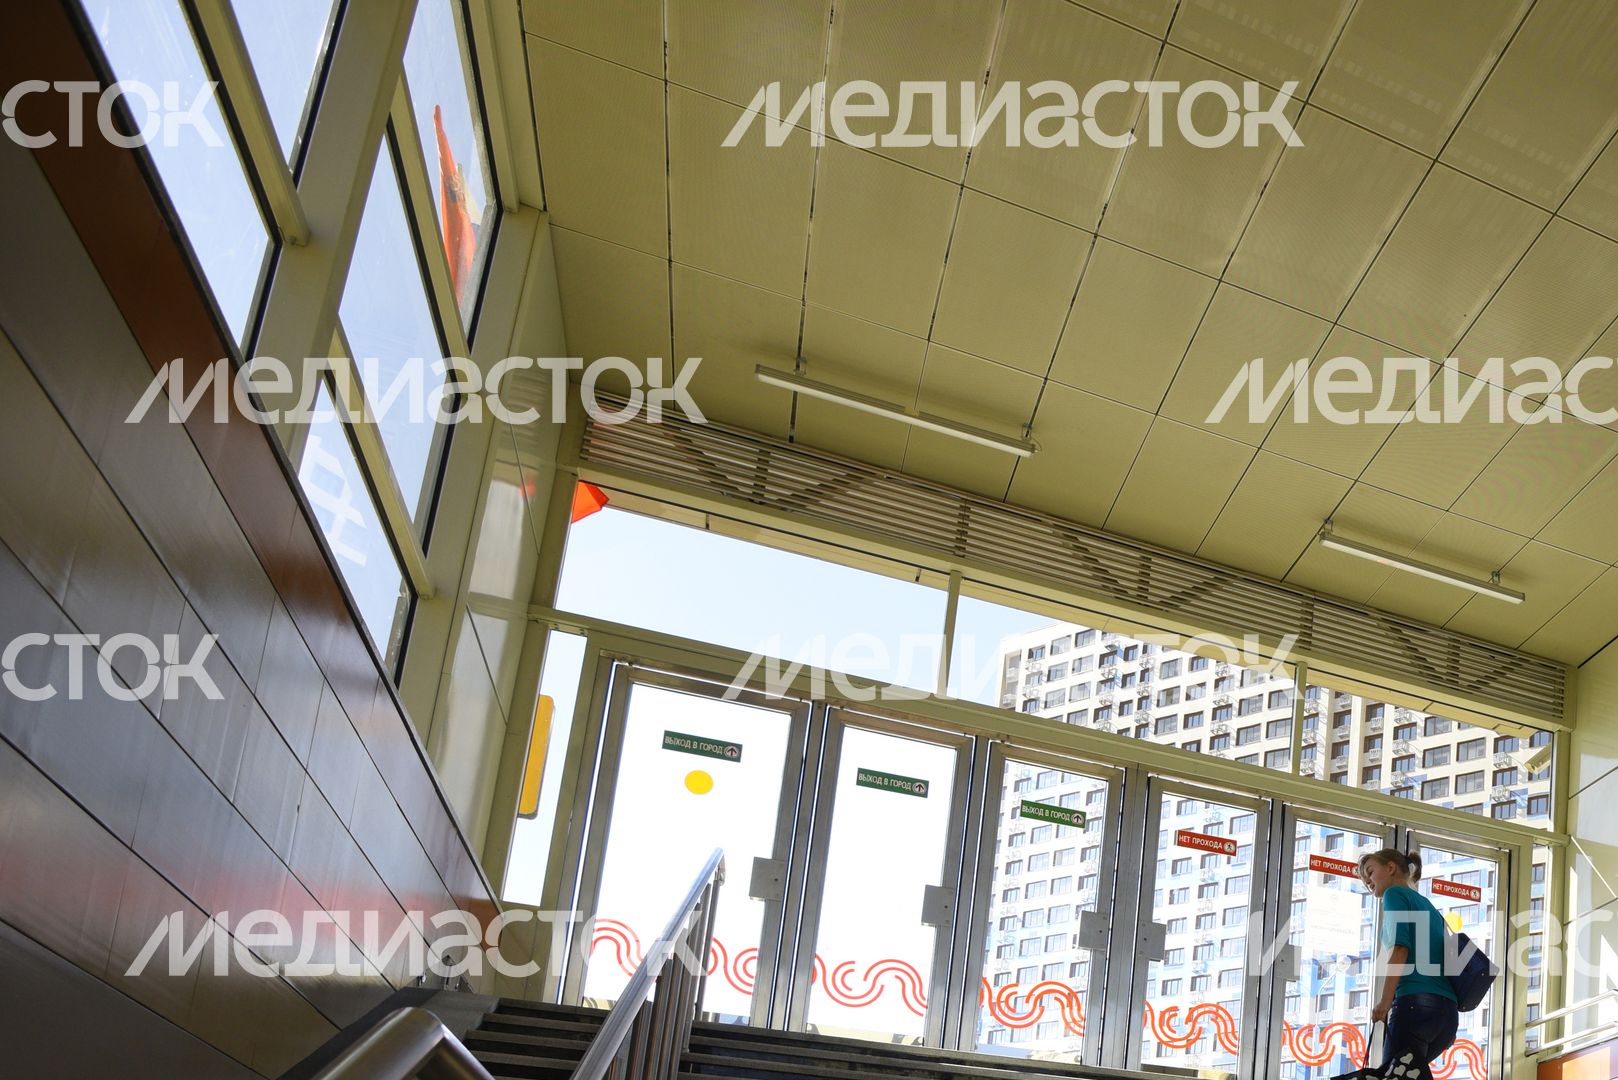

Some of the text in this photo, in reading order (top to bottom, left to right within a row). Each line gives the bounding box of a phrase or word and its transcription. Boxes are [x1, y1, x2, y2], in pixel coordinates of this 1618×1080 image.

[664, 736, 723, 755] ВЫХОД В ГОРОД
[858, 773, 912, 791] ВЫХОД В ГОРОД
[1021, 805, 1044, 816] ВЫХОД
[1050, 810, 1070, 821] ГОРОД
[1192, 837, 1223, 849] ПРОХОДА
[1322, 861, 1351, 873] ПРОХОДА
[1443, 885, 1470, 896] ПРОХОДА
